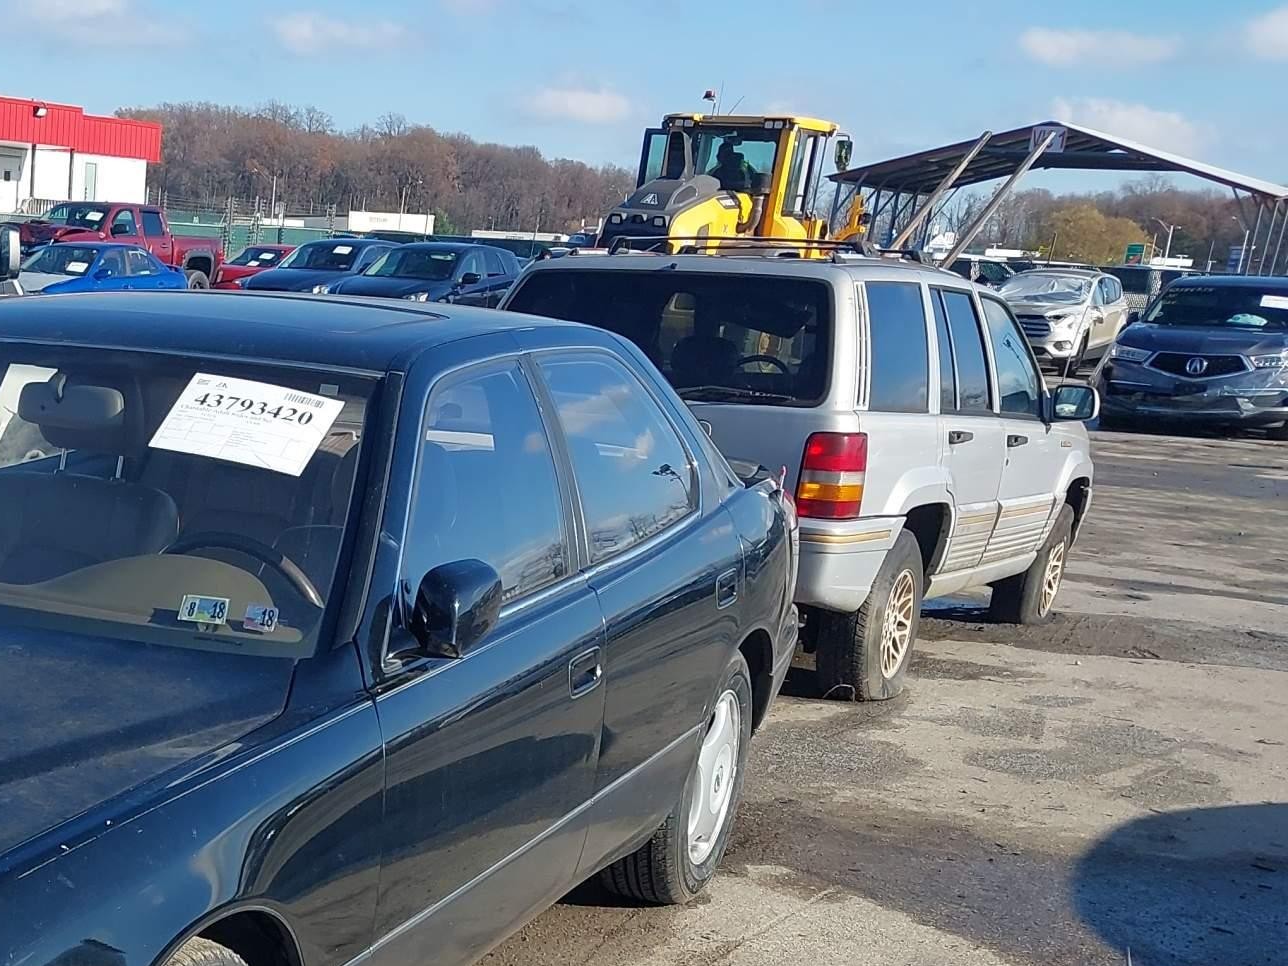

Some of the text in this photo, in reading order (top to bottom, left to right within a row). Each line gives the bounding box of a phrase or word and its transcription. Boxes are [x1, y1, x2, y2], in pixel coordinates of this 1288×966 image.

[193, 391, 314, 426] 43793420
[211, 601, 226, 619] 18
[260, 608, 275, 628] 18
